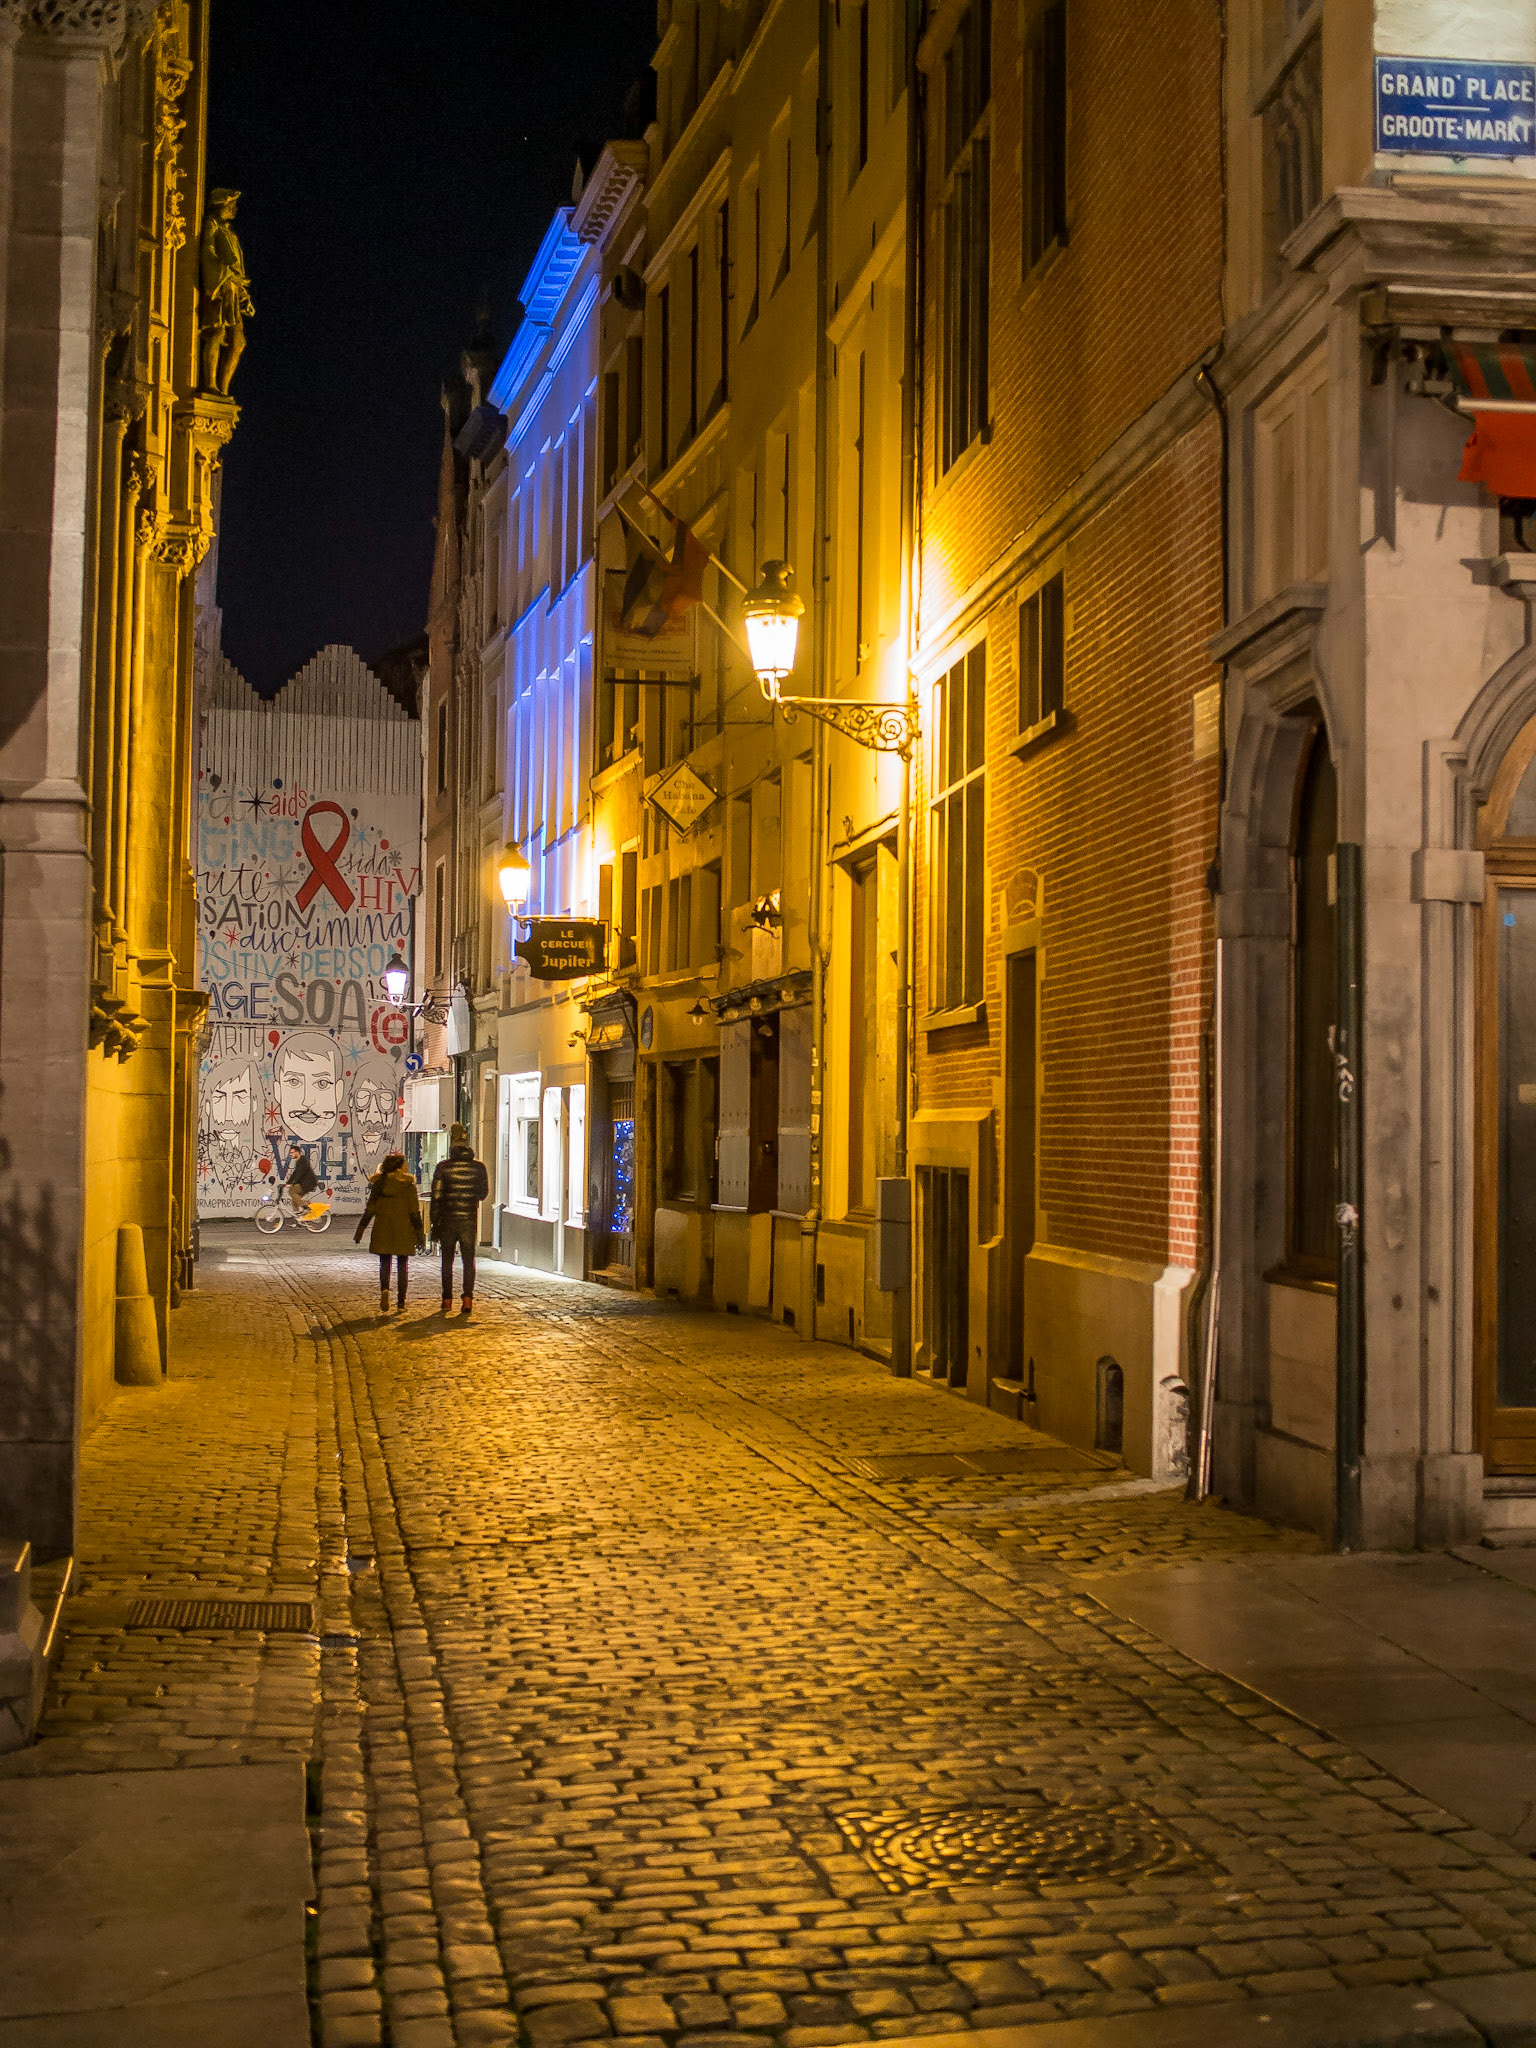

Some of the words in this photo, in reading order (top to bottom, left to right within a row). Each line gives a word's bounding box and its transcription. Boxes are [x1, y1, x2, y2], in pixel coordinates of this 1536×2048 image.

[1466, 78, 1534, 102] PLACE
[1382, 115, 1530, 143] GROOTE-MARKT
[269, 781, 308, 819] aids
[338, 844, 391, 876] sida
[357, 867, 419, 915] HIV
[561, 930, 574, 938] LE
[542, 954, 592, 970] Jupiler
